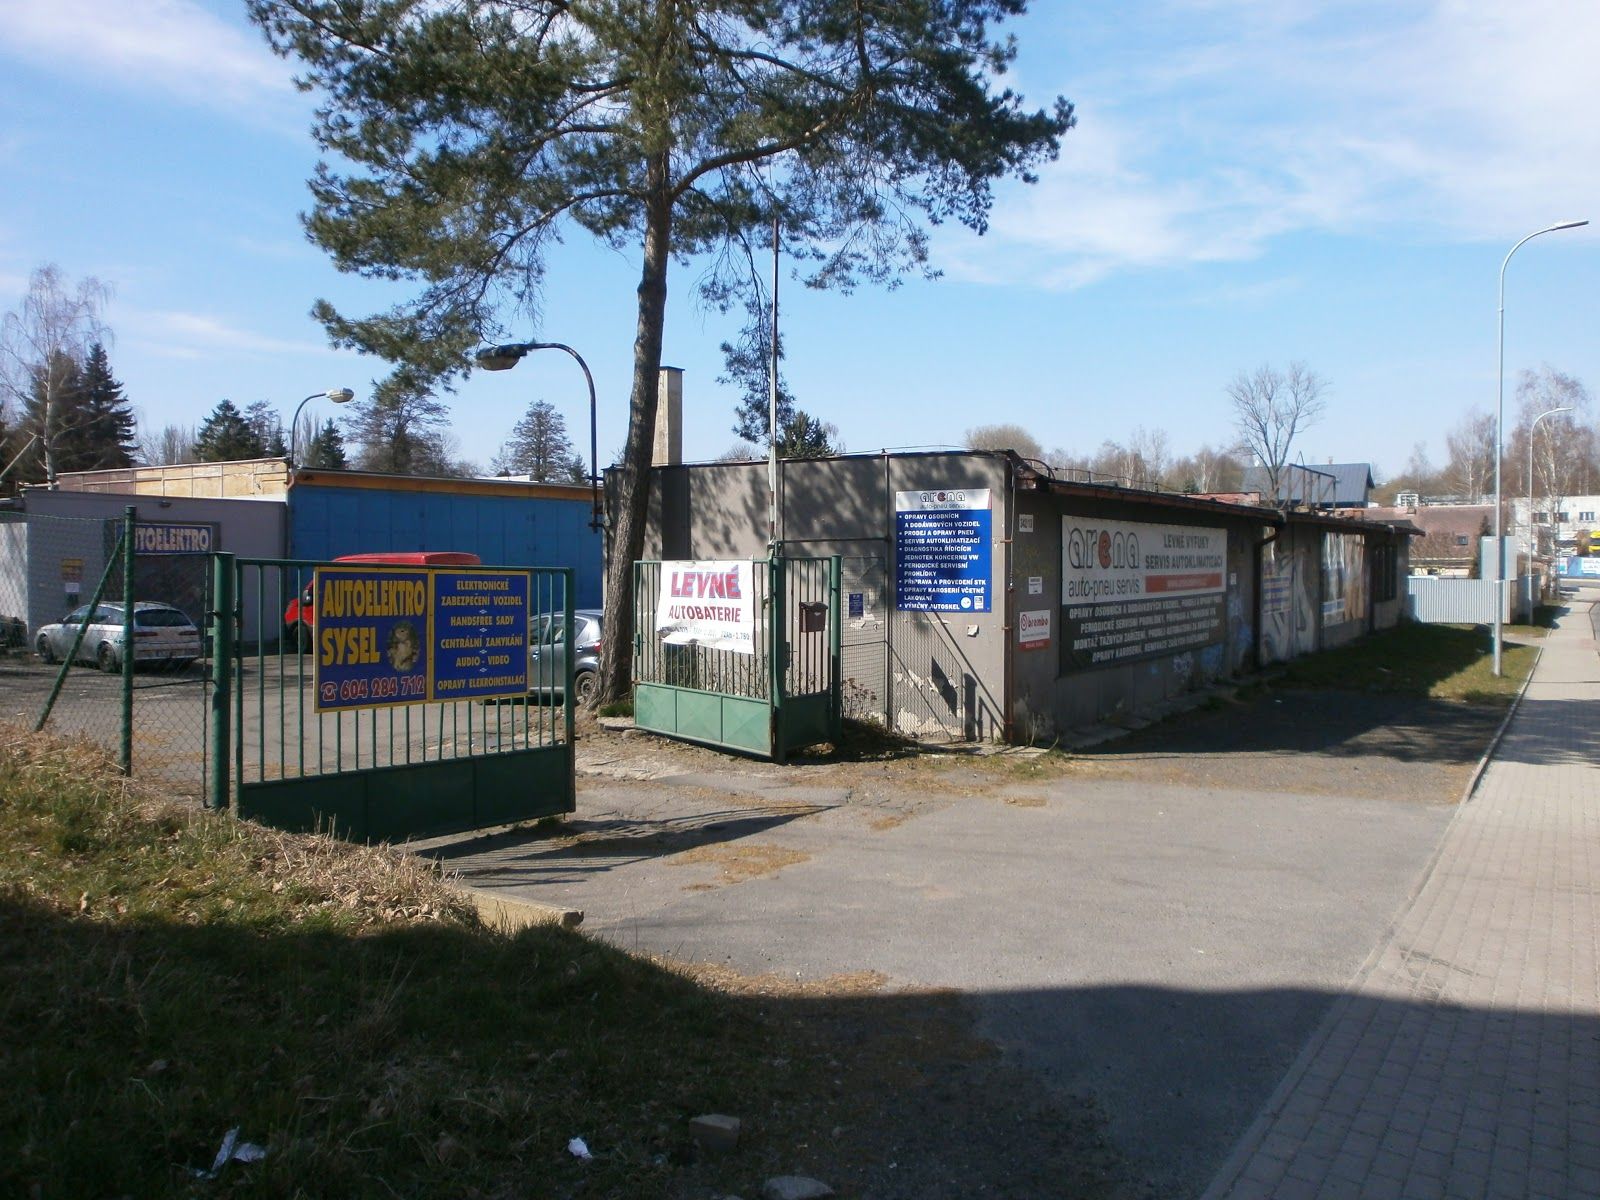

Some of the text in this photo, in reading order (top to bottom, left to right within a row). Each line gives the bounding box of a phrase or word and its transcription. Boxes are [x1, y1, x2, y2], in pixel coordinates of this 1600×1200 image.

[920, 491, 965, 502] arena
[910, 520, 953, 528] DODÁVKOVÝCH
[135, 528, 209, 551] TOELEKTRO
[926, 536, 980, 544] AUTOKLIMATIZACÍ
[944, 544, 972, 552] ŘÍDÍCÍCH
[1068, 527, 1140, 569] arena
[904, 561, 968, 569] PERIODICKÉ SERVISNÍ
[1145, 554, 1170, 569] SERVIS
[904, 569, 937, 577] PROHLÍDKY
[456, 578, 509, 590] ELEKTRONICKÉ
[671, 564, 742, 599] LEVNÉ
[1068, 574, 1140, 600] auto-pneu servis
[927, 586, 960, 594] KAROSERIÍ
[960, 586, 985, 594] VČETNĚ
[322, 580, 425, 617] AUTOELEKTRO
[441, 592, 523, 606] ZABEZPEČENÍ VOZIDEL
[450, 615, 514, 626] HANDSFREE SADY
[668, 605, 742, 623] AUTOBATERIE
[322, 627, 381, 667] SYSEL
[440, 633, 523, 649] CENTRÁLNÍ ZAMYKÁNÍ
[455, 656, 480, 667] AUDIO
[487, 655, 509, 665] VIDEO
[340, 674, 425, 700] 604 284 712
[437, 672, 526, 690] OPRAVY ELEKROINSTALACÍ
